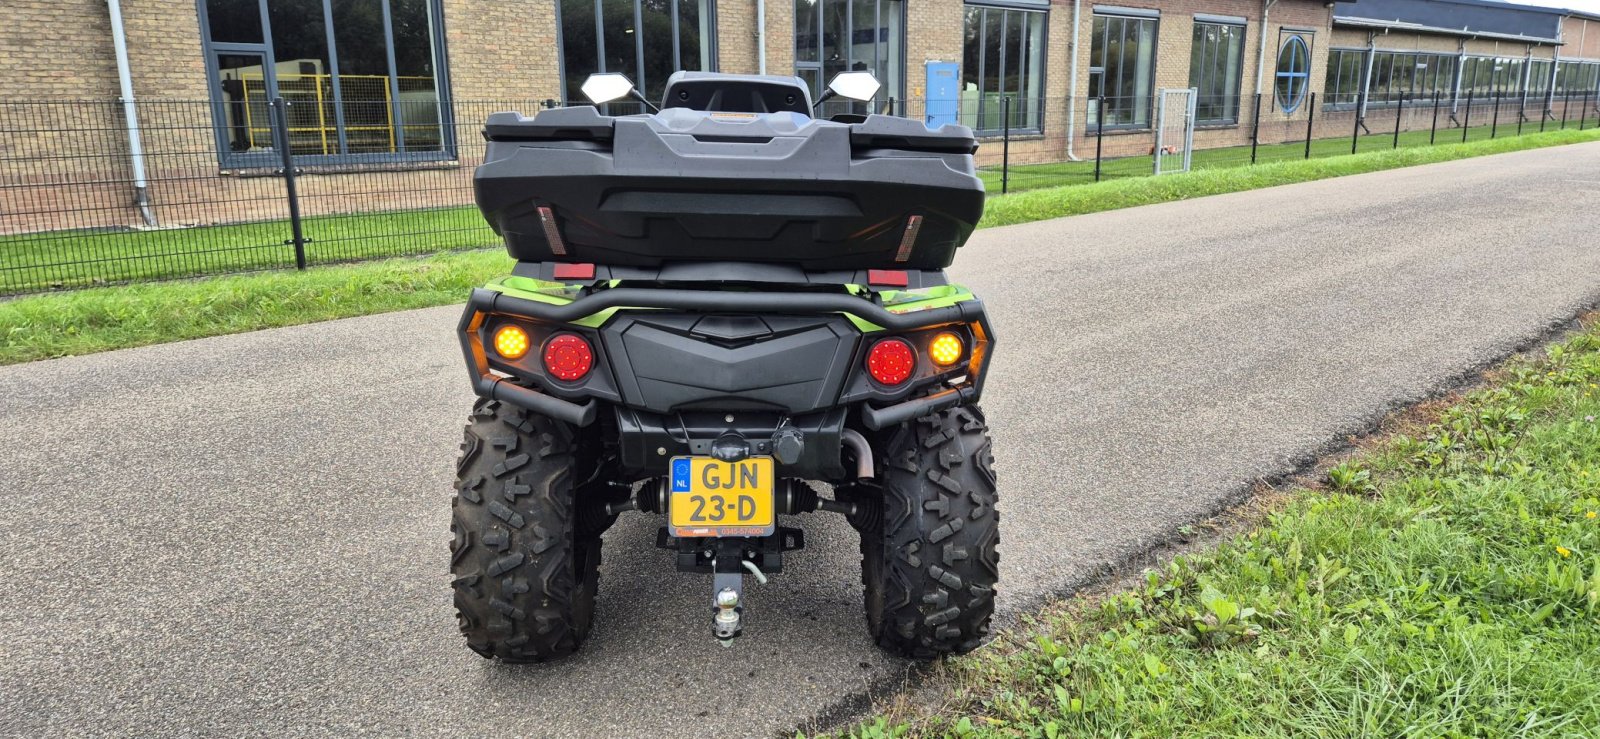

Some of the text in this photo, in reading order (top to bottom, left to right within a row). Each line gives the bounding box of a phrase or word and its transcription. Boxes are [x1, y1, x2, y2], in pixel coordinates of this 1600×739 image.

[676, 480, 687, 488] NL
[702, 463, 758, 489] GJN
[690, 495, 756, 521] 23-D
